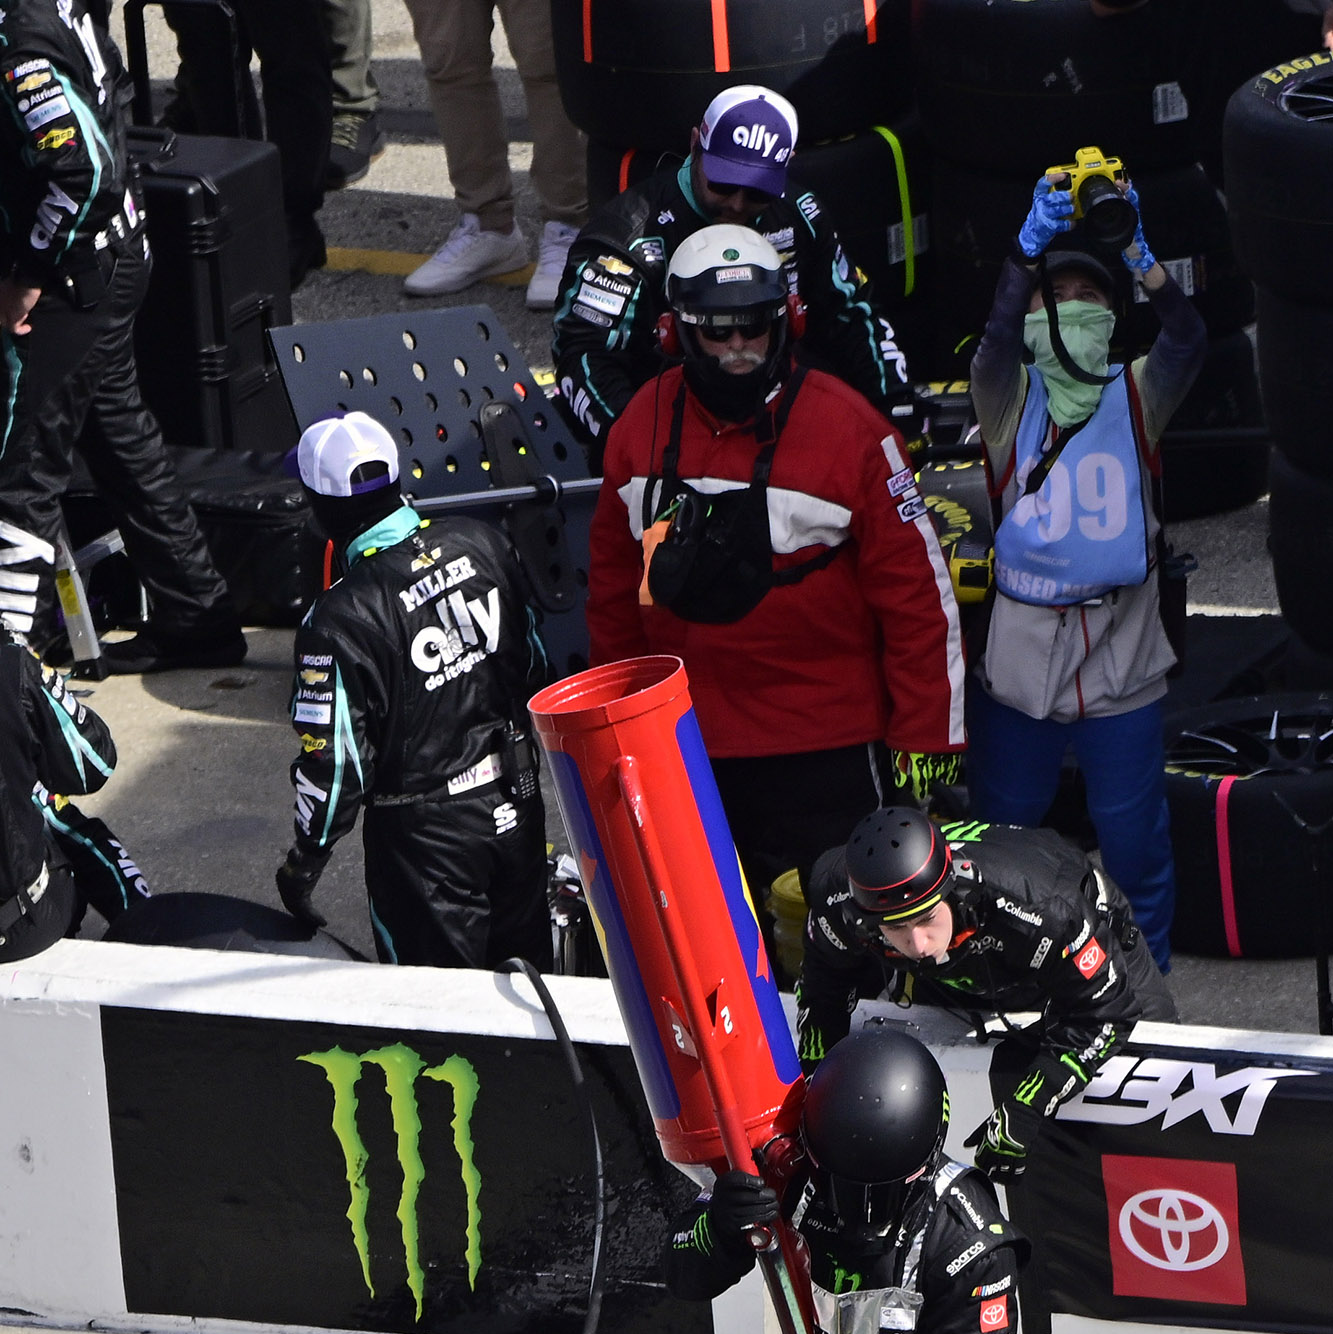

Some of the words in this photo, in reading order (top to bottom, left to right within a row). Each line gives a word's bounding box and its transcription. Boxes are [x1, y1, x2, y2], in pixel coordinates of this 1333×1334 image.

[29, 85, 64, 107] Atrium
[732, 124, 779, 158] ally
[594, 274, 633, 296] Atrium
[399, 556, 477, 613] MILLER
[410, 587, 500, 673] ally
[302, 653, 333, 667] ASCAR
[1004, 900, 1043, 927] Columbia
[945, 1241, 985, 1276] sparco
